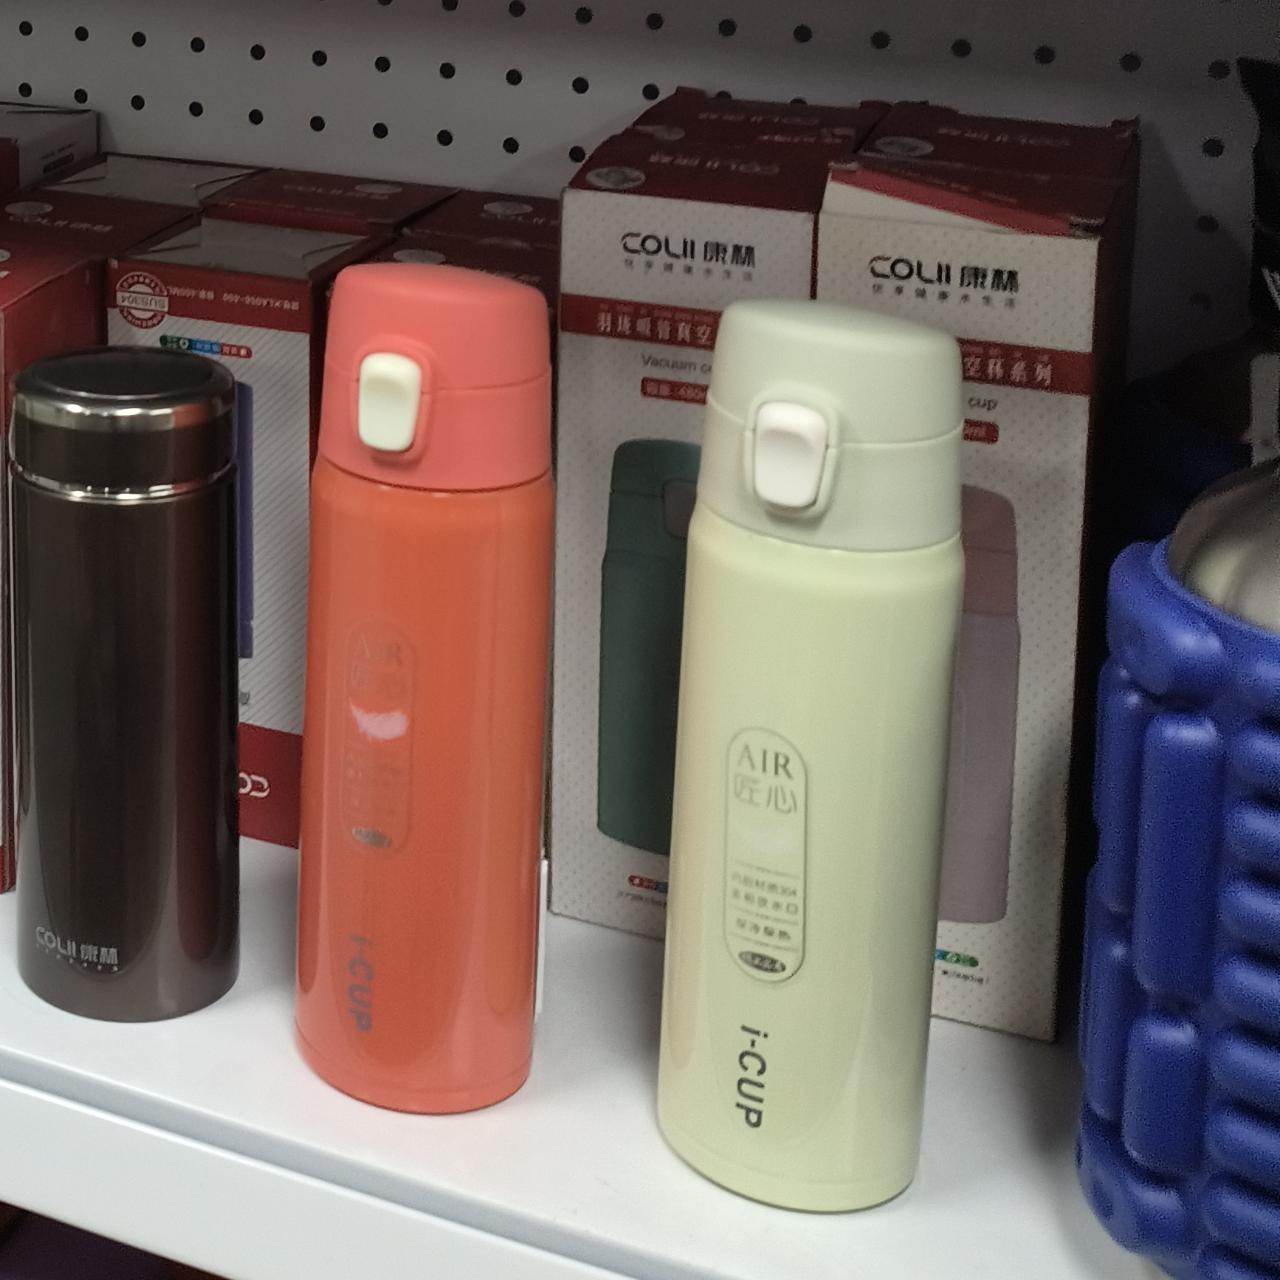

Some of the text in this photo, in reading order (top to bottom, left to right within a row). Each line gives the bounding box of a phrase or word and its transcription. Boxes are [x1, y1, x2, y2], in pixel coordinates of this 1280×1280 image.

[621, 231, 756, 268] COLII 康林
[869, 255, 1020, 294] COLII 康林
[640, 353, 698, 372] Vacuum
[967, 396, 999, 412] cup
[737, 743, 796, 781] AIR
[733, 772, 799, 816] 匠心
[80, 943, 119, 965] 康林
[734, 1022, 770, 1130] i-CUP
